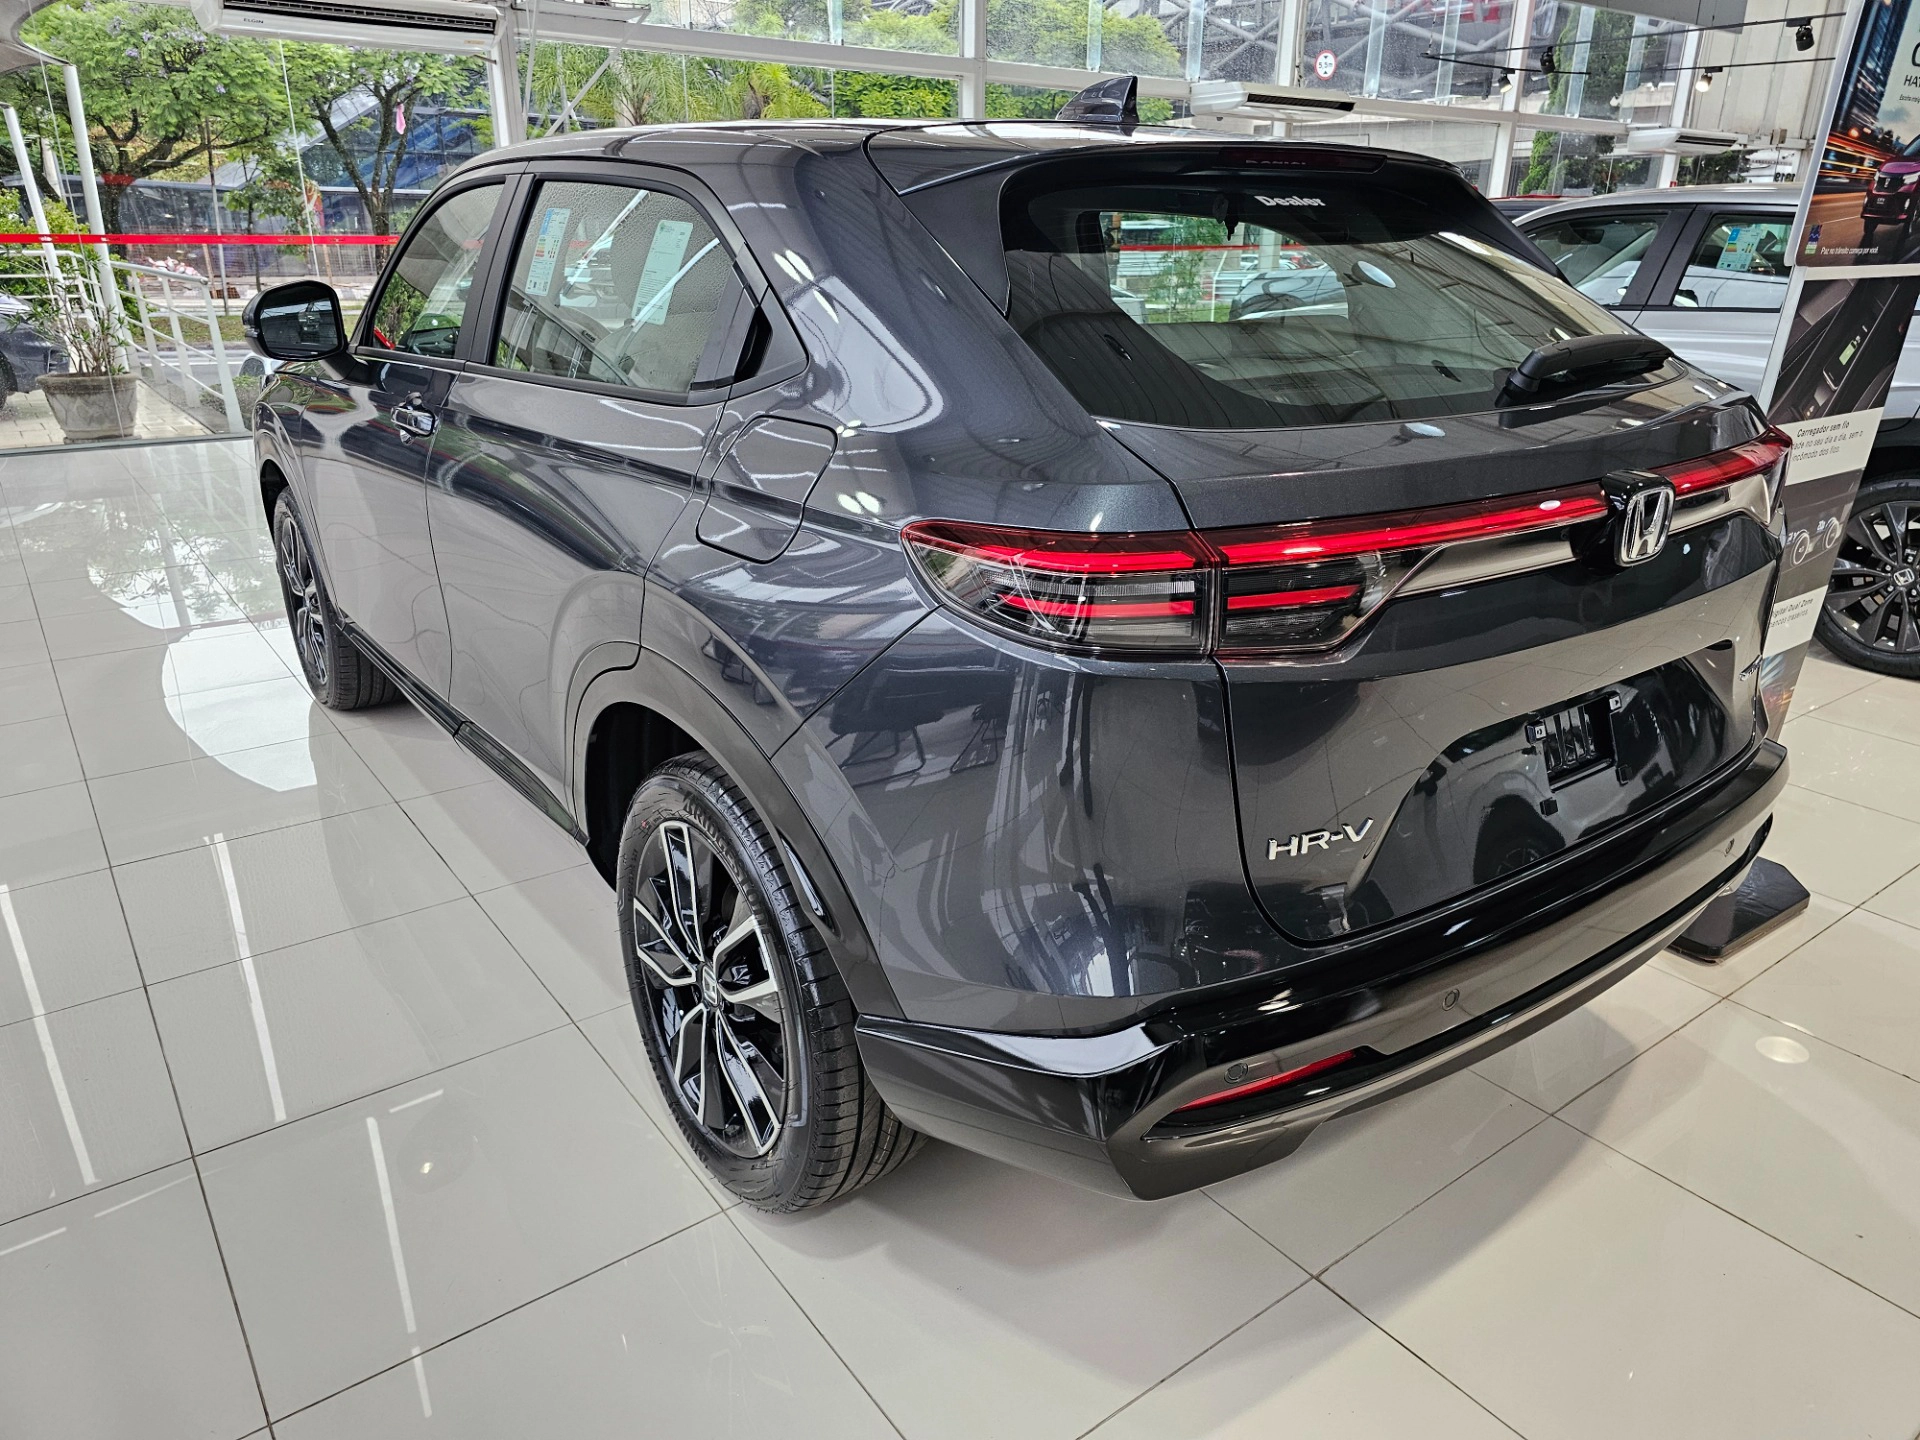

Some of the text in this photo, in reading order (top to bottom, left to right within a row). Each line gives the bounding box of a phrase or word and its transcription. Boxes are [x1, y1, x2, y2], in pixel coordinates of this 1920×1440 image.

[1253, 195, 1326, 207] Dealer
[1797, 420, 1850, 438] Carregador sem fio
[1788, 602, 1802, 612] Dual
[1801, 599, 1813, 607] Zone
[1266, 816, 1375, 861] HR-V
